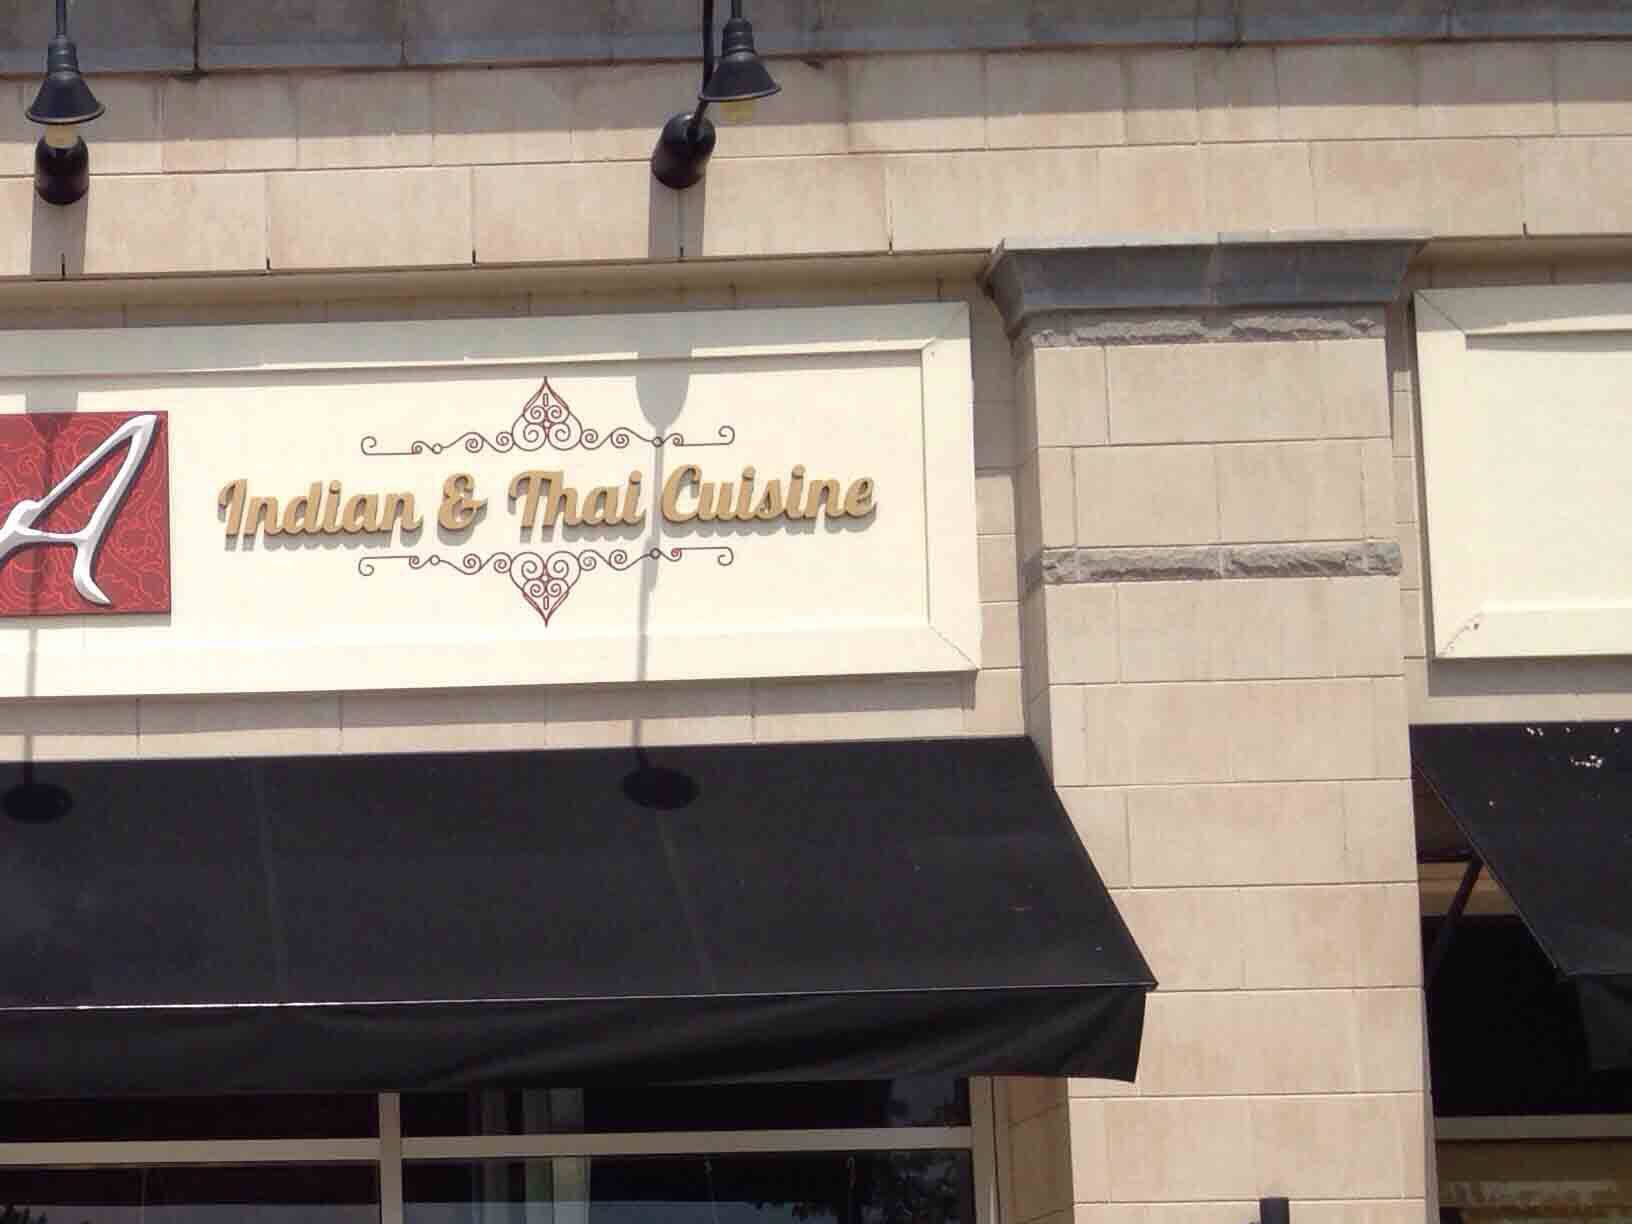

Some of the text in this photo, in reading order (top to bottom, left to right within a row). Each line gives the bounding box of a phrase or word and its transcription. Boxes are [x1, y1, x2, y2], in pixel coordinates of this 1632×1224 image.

[216, 463, 877, 537] Indian & Thai Cuisine
